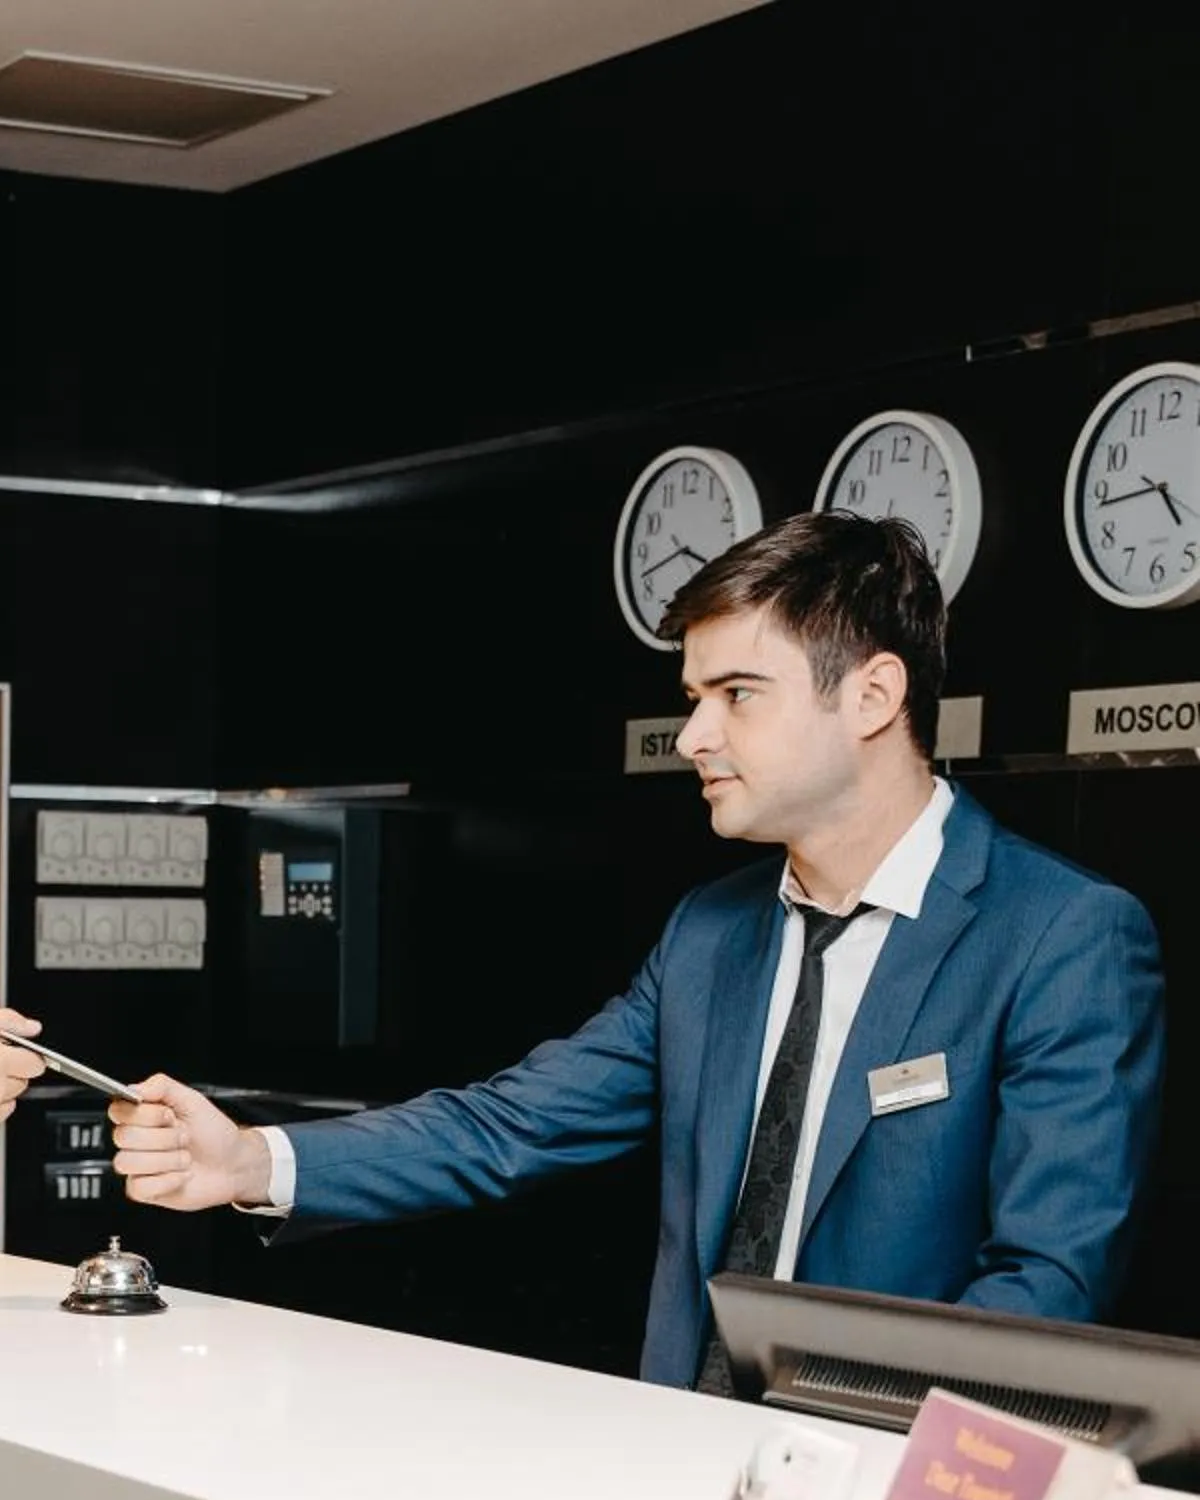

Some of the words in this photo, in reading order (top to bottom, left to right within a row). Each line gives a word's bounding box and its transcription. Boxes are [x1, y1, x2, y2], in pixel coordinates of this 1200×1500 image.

[1157, 390, 1184, 422] 12
[1129, 407, 1148, 438] 11
[867, 449, 883, 476] 11
[891, 435, 912, 463] 12
[921, 444, 930, 471] 1
[1105, 441, 1128, 473] 10
[662, 483, 675, 509] 11
[682, 468, 700, 496] 12
[847, 479, 866, 506] 10
[934, 469, 950, 498] 2
[646, 511, 662, 537] 10
[1101, 520, 1116, 550] 8
[1122, 546, 1137, 577] 7
[1149, 552, 1166, 584] 6
[1180, 542, 1197, 574] 5
[1094, 702, 1200, 735] MOSCO
